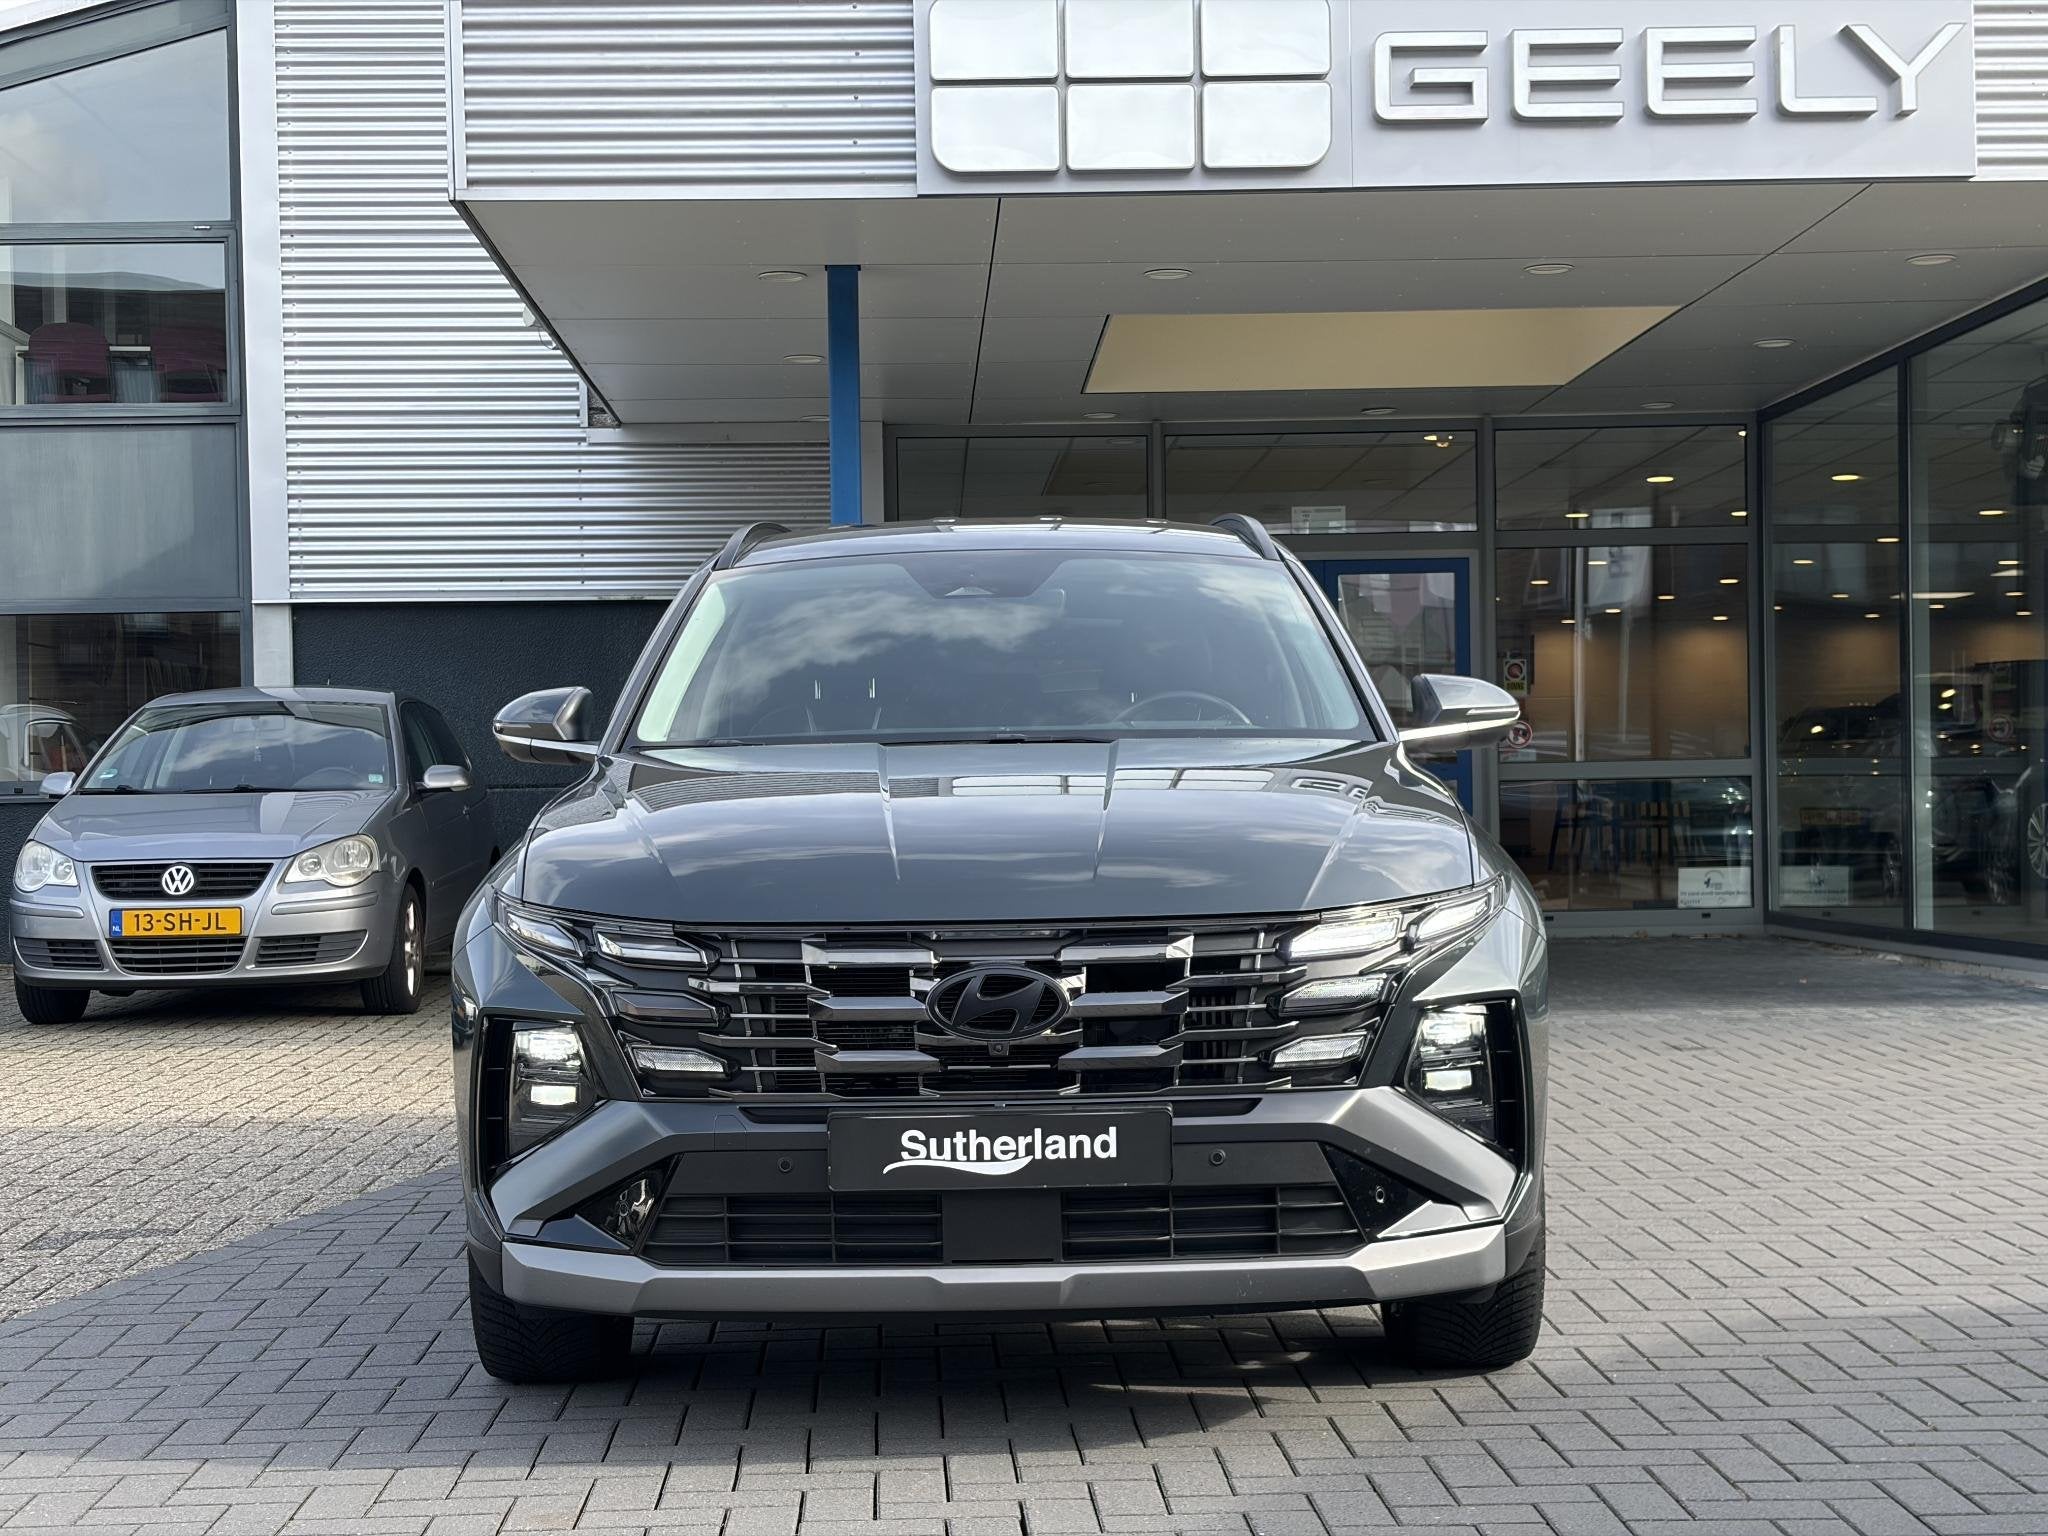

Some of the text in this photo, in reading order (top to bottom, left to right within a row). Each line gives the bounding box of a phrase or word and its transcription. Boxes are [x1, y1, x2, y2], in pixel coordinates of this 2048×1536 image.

[1370, 22, 1966, 124] GEELY
[134, 912, 226, 931] 13-SH-JL
[901, 1126, 1118, 1162] Sutherland
